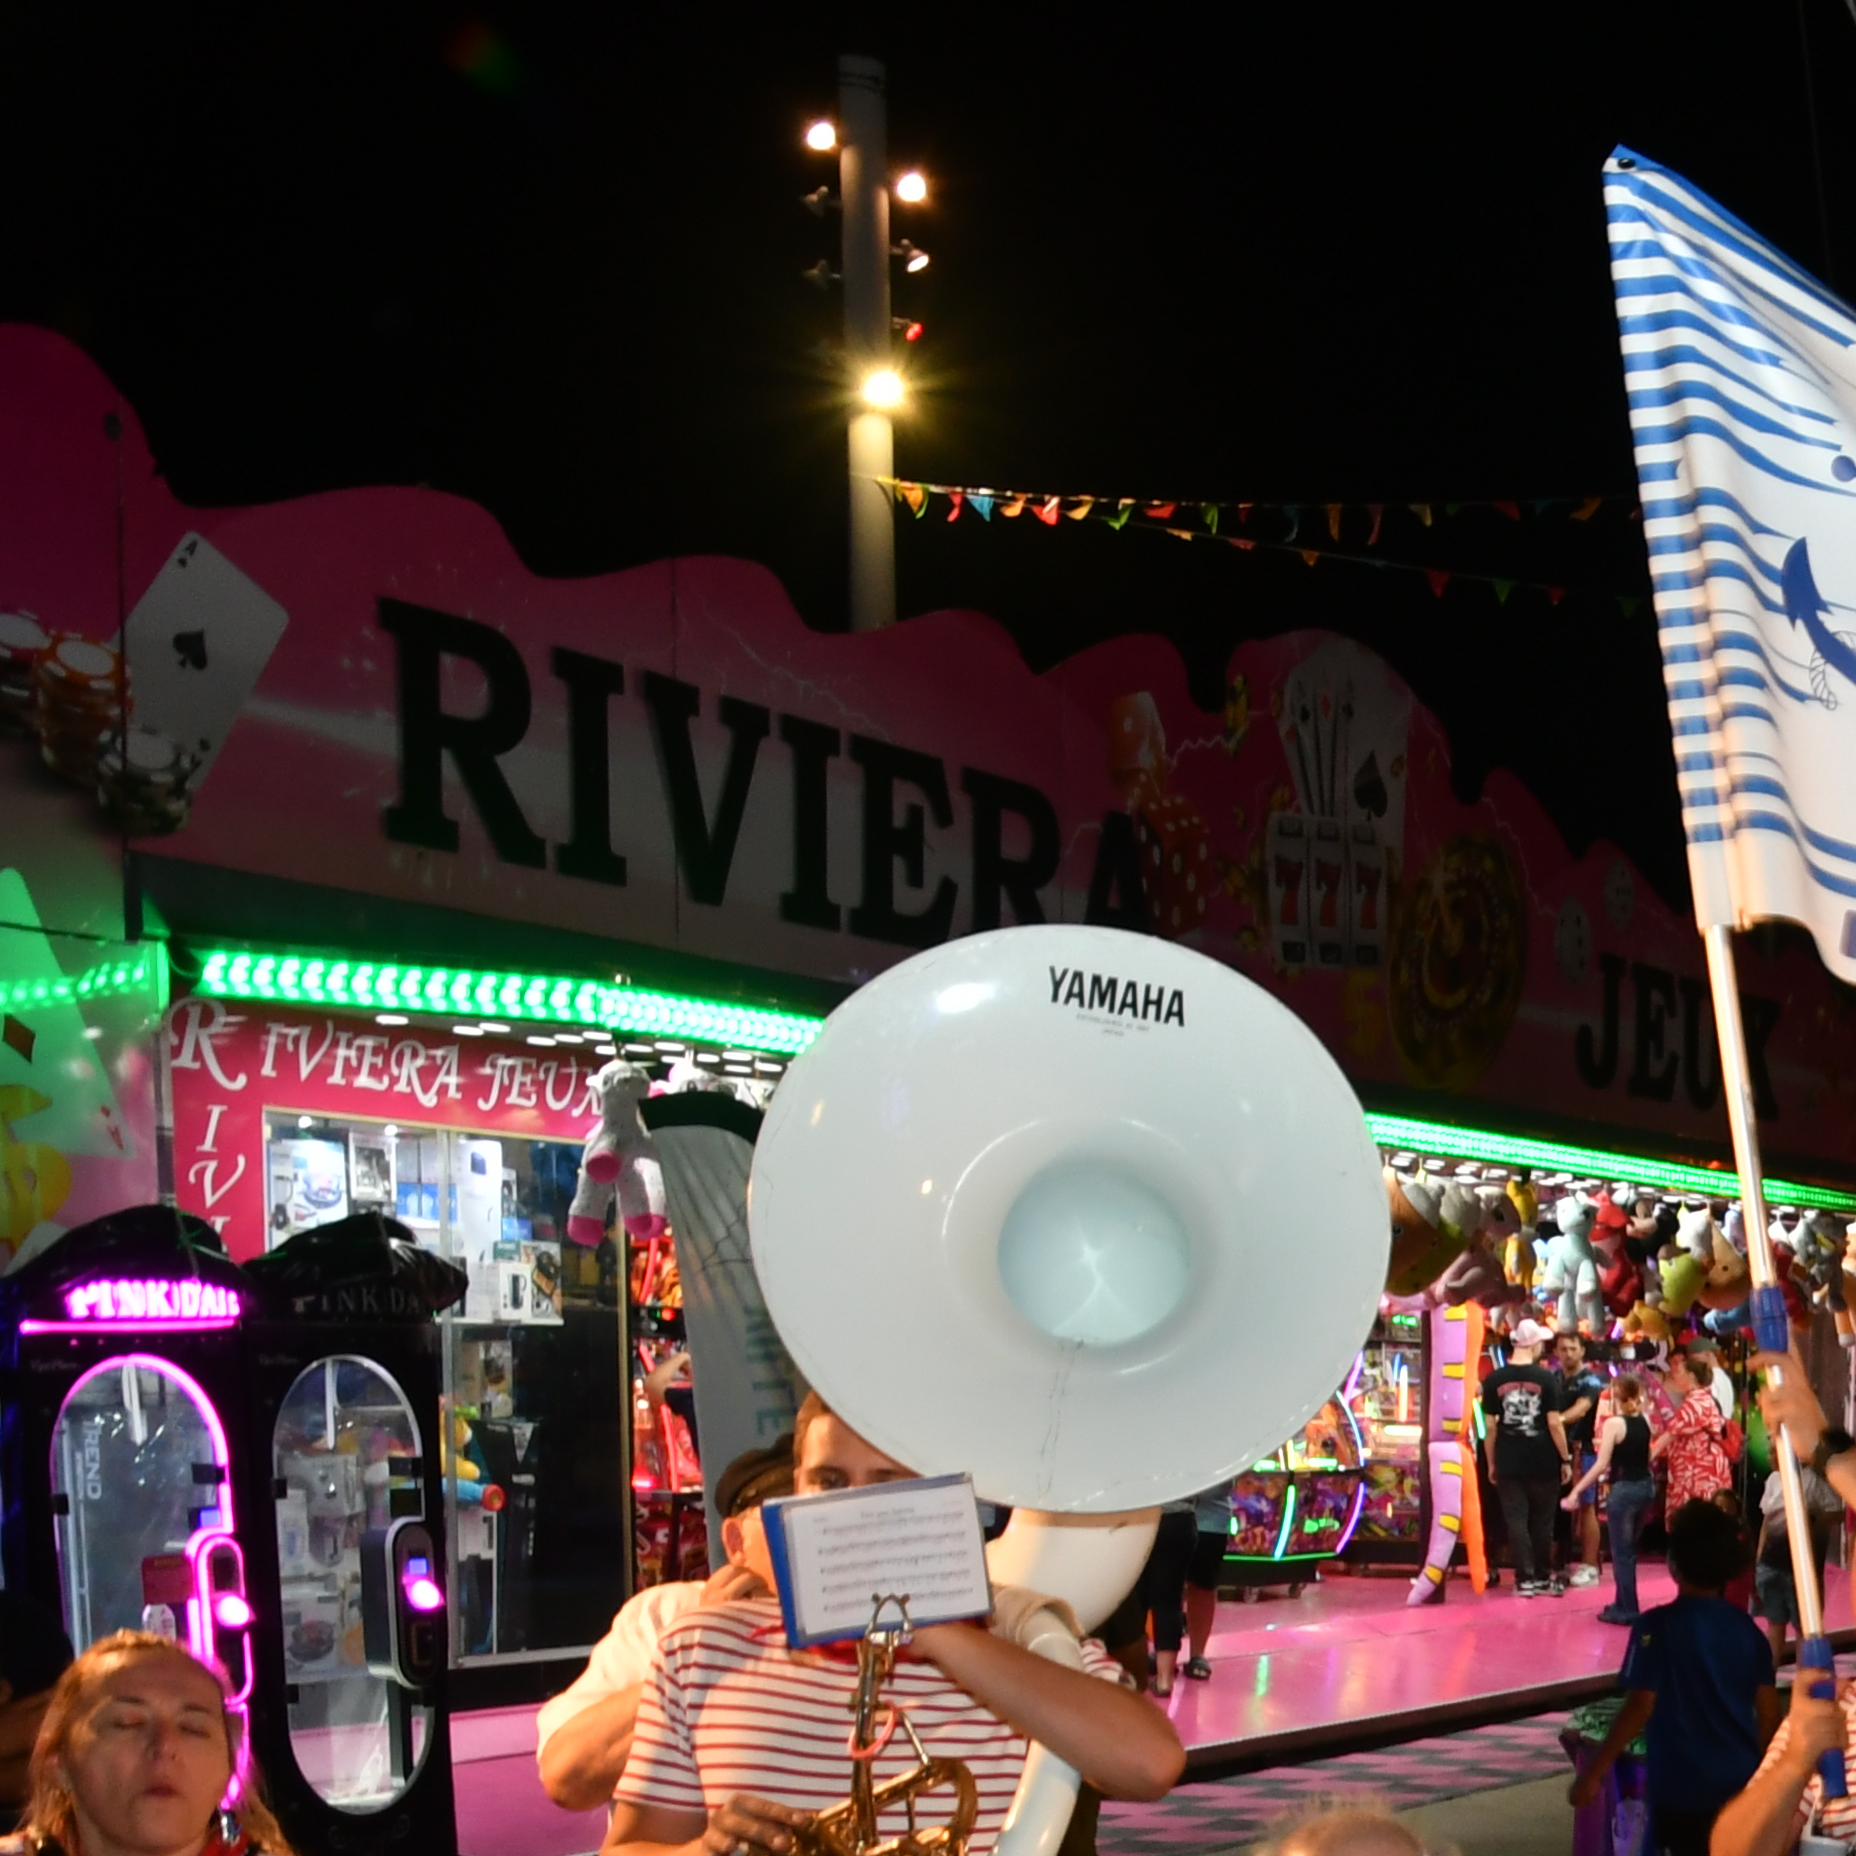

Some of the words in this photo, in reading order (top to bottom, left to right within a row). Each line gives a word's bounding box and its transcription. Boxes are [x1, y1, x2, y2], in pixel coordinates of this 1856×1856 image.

[376, 597, 1152, 945] RIVIERA
[166, 996, 463, 1108] RIVIERA
[1048, 964, 1186, 1029] YAMAHA
